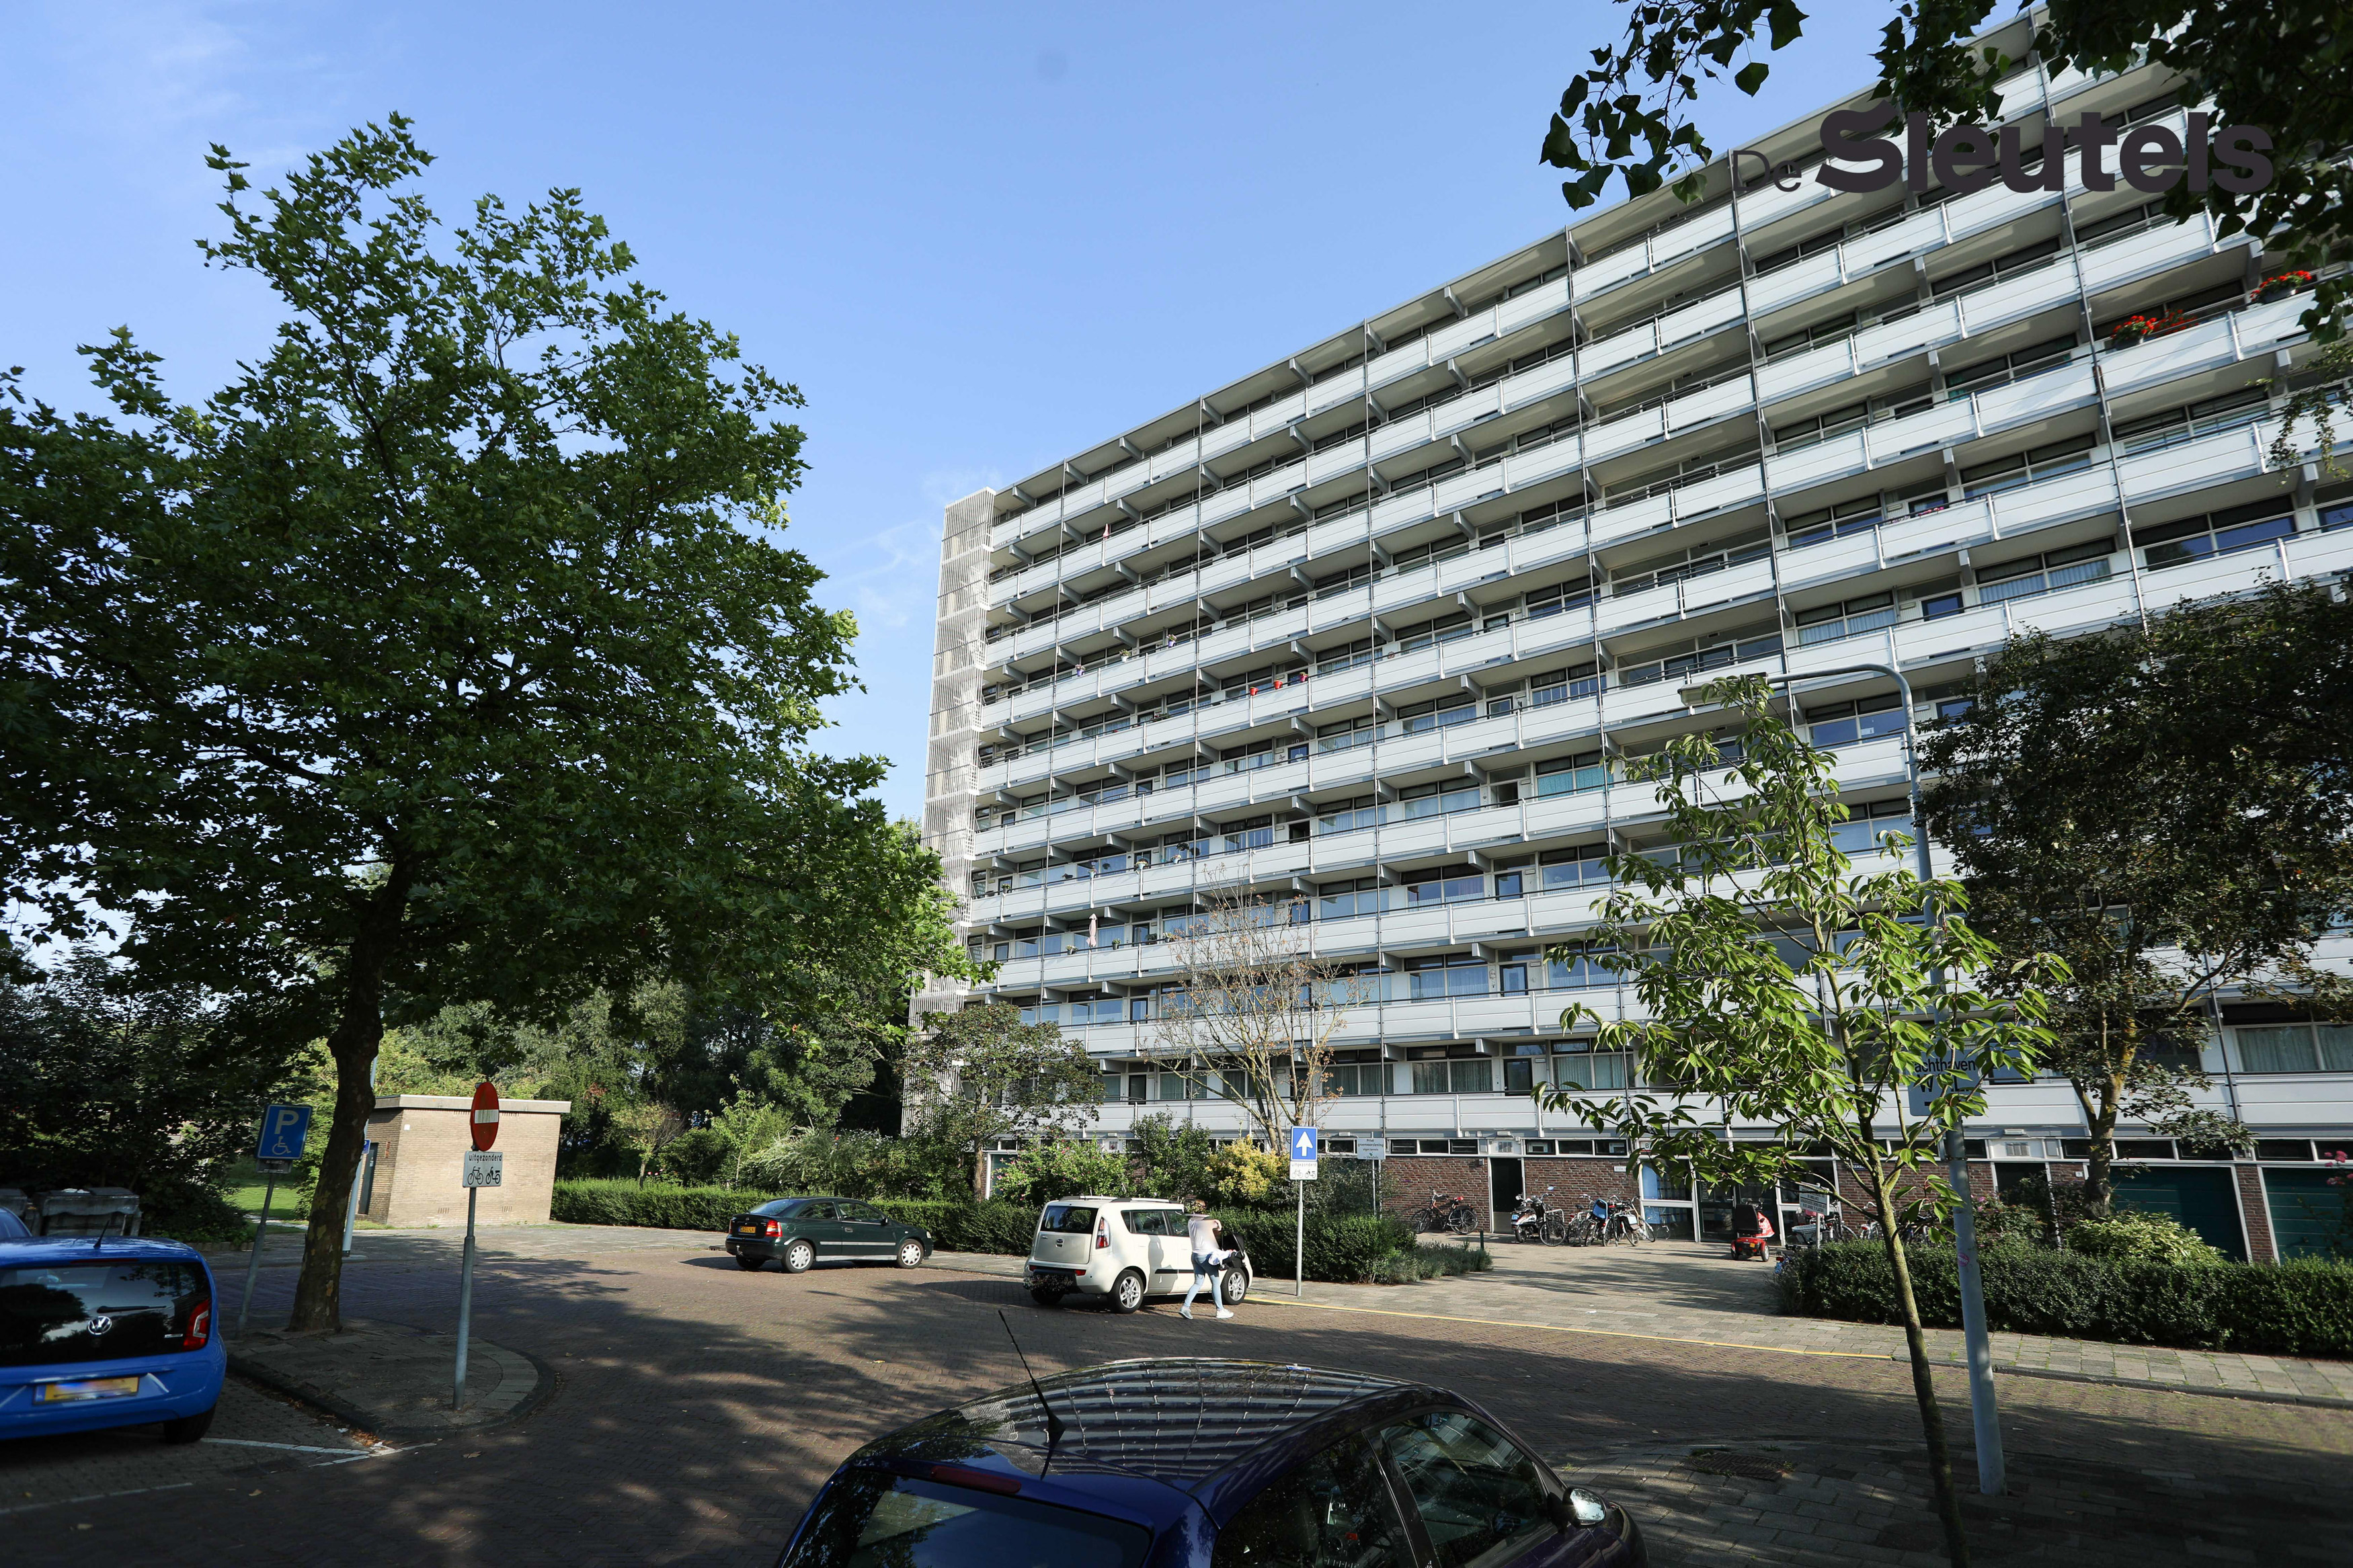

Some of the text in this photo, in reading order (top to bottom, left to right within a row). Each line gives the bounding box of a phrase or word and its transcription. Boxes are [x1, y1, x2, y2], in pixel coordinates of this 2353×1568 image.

[1911, 1057, 1977, 1073] achthaven
[274, 1110, 300, 1134] P
[469, 1153, 502, 1163] uitgezonderd
